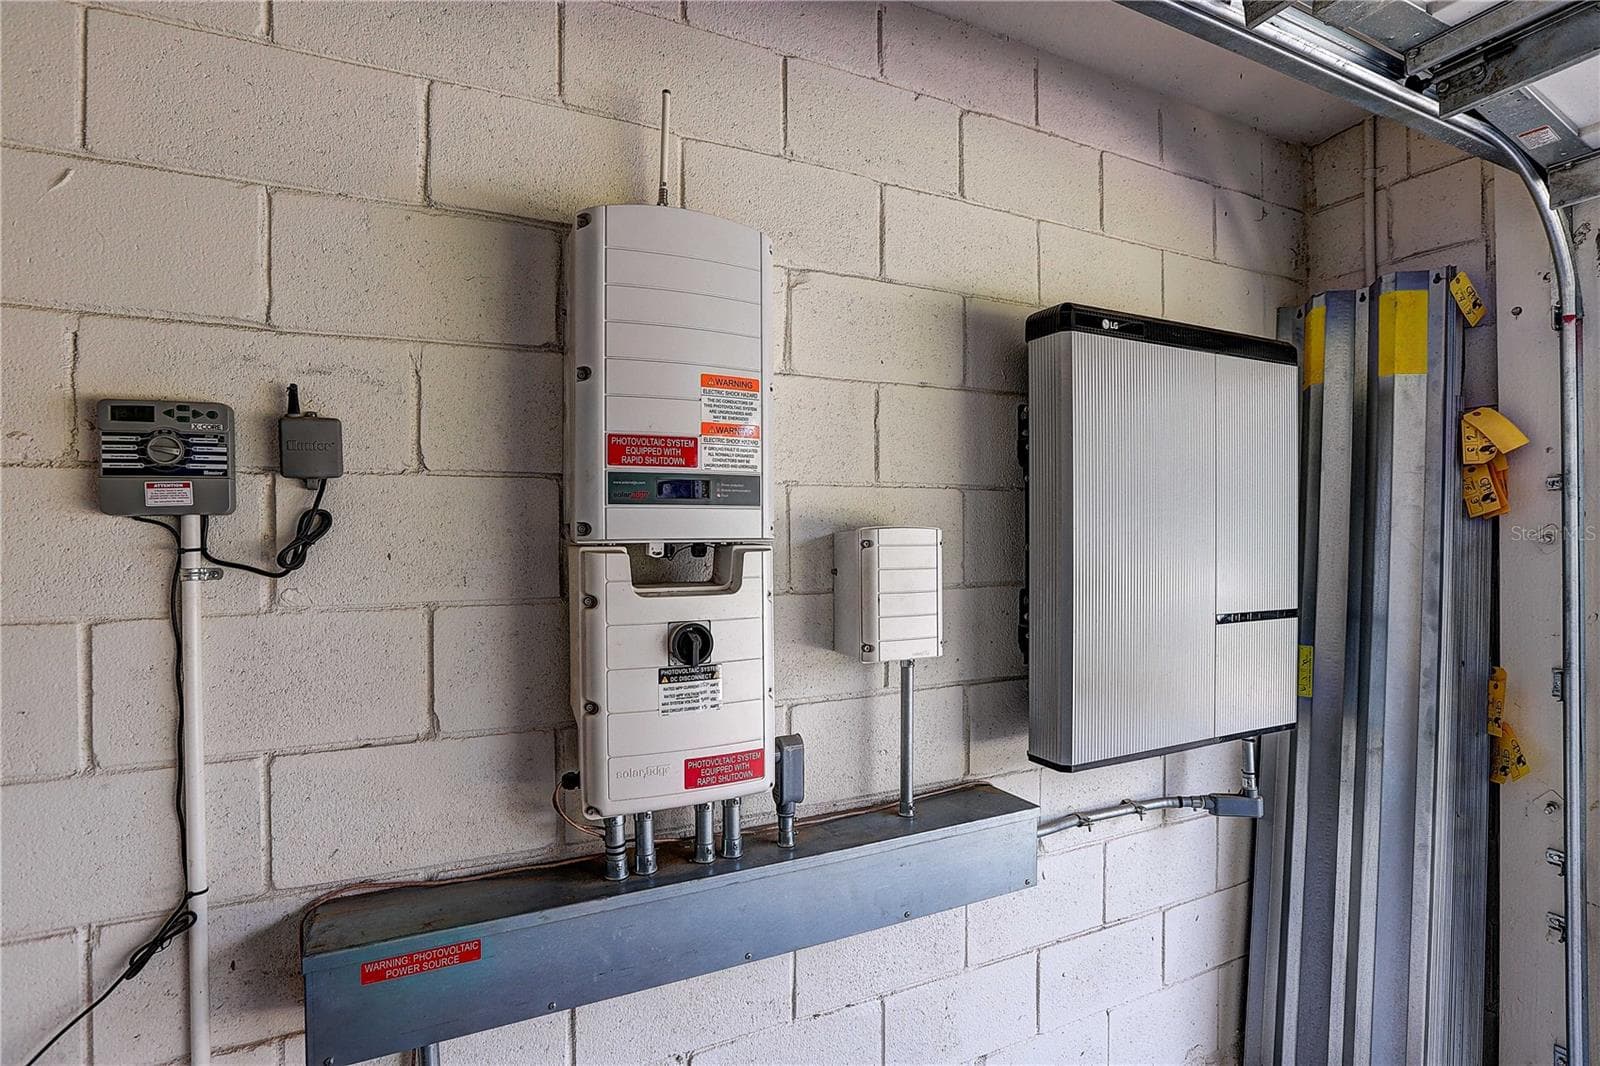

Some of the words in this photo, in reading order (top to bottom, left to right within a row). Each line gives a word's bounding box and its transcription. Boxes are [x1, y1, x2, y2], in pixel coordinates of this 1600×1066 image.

[1110, 321, 1118, 330] LG
[715, 378, 752, 389] WARNING
[716, 426, 753, 436] WARNING
[611, 436, 666, 446] PHOTOVOLTAIC
[667, 439, 694, 448] SYSTEM
[626, 446, 662, 455] EQUIPPED
[621, 456, 643, 464] RAPID
[644, 457, 685, 465] SHUTDOWN
[661, 667, 699, 675] PHOTOVOLTAIC
[679, 674, 712, 682] DISCONNECT
[688, 756, 736, 769] PHOTOVOLTAIC
[738, 752, 760, 762] SYSTEM
[701, 765, 733, 776] EQUIPPED
[697, 776, 716, 786] RAPID
[718, 770, 753, 783] SHUTDOWN
[365, 956, 411, 973] WARNING:
[413, 941, 478, 961] PHOTOVOLTAIC
[386, 963, 420, 978] POWER
[422, 956, 460, 970] SOURCE
